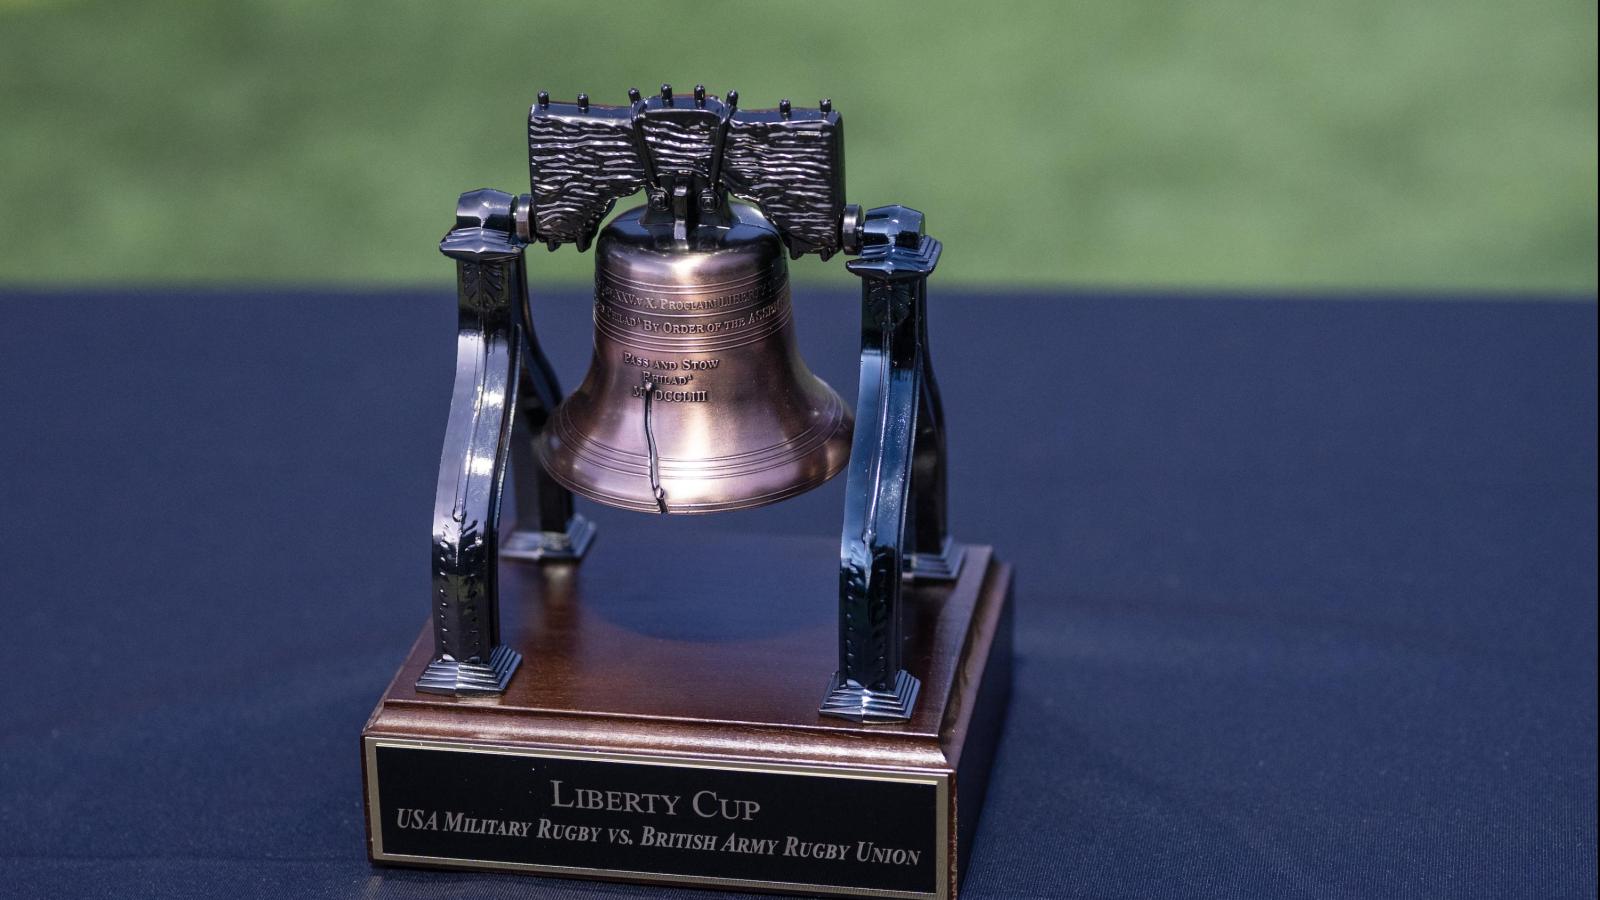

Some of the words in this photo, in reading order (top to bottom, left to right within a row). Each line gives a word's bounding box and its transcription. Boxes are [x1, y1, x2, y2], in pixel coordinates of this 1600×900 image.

[660, 298, 718, 311] PROCLAIM
[643, 319, 660, 332] BY
[663, 322, 704, 334] ORDER
[707, 322, 721, 333] OF
[724, 317, 746, 330] THE
[624, 351, 650, 368] PASS
[654, 360, 678, 370] AND
[682, 359, 719, 370] STOW
[550, 779, 681, 815] LIBERTY
[692, 790, 761, 821] CUP
[397, 808, 438, 831] USA
[442, 811, 532, 837] MILITARY
[536, 818, 602, 843] RUGBY
[608, 827, 634, 846] VS.
[640, 825, 718, 852] BRITISH
[720, 832, 780, 856] ARMY
[783, 836, 851, 861] RUGBY
[856, 841, 921, 866] UNION
